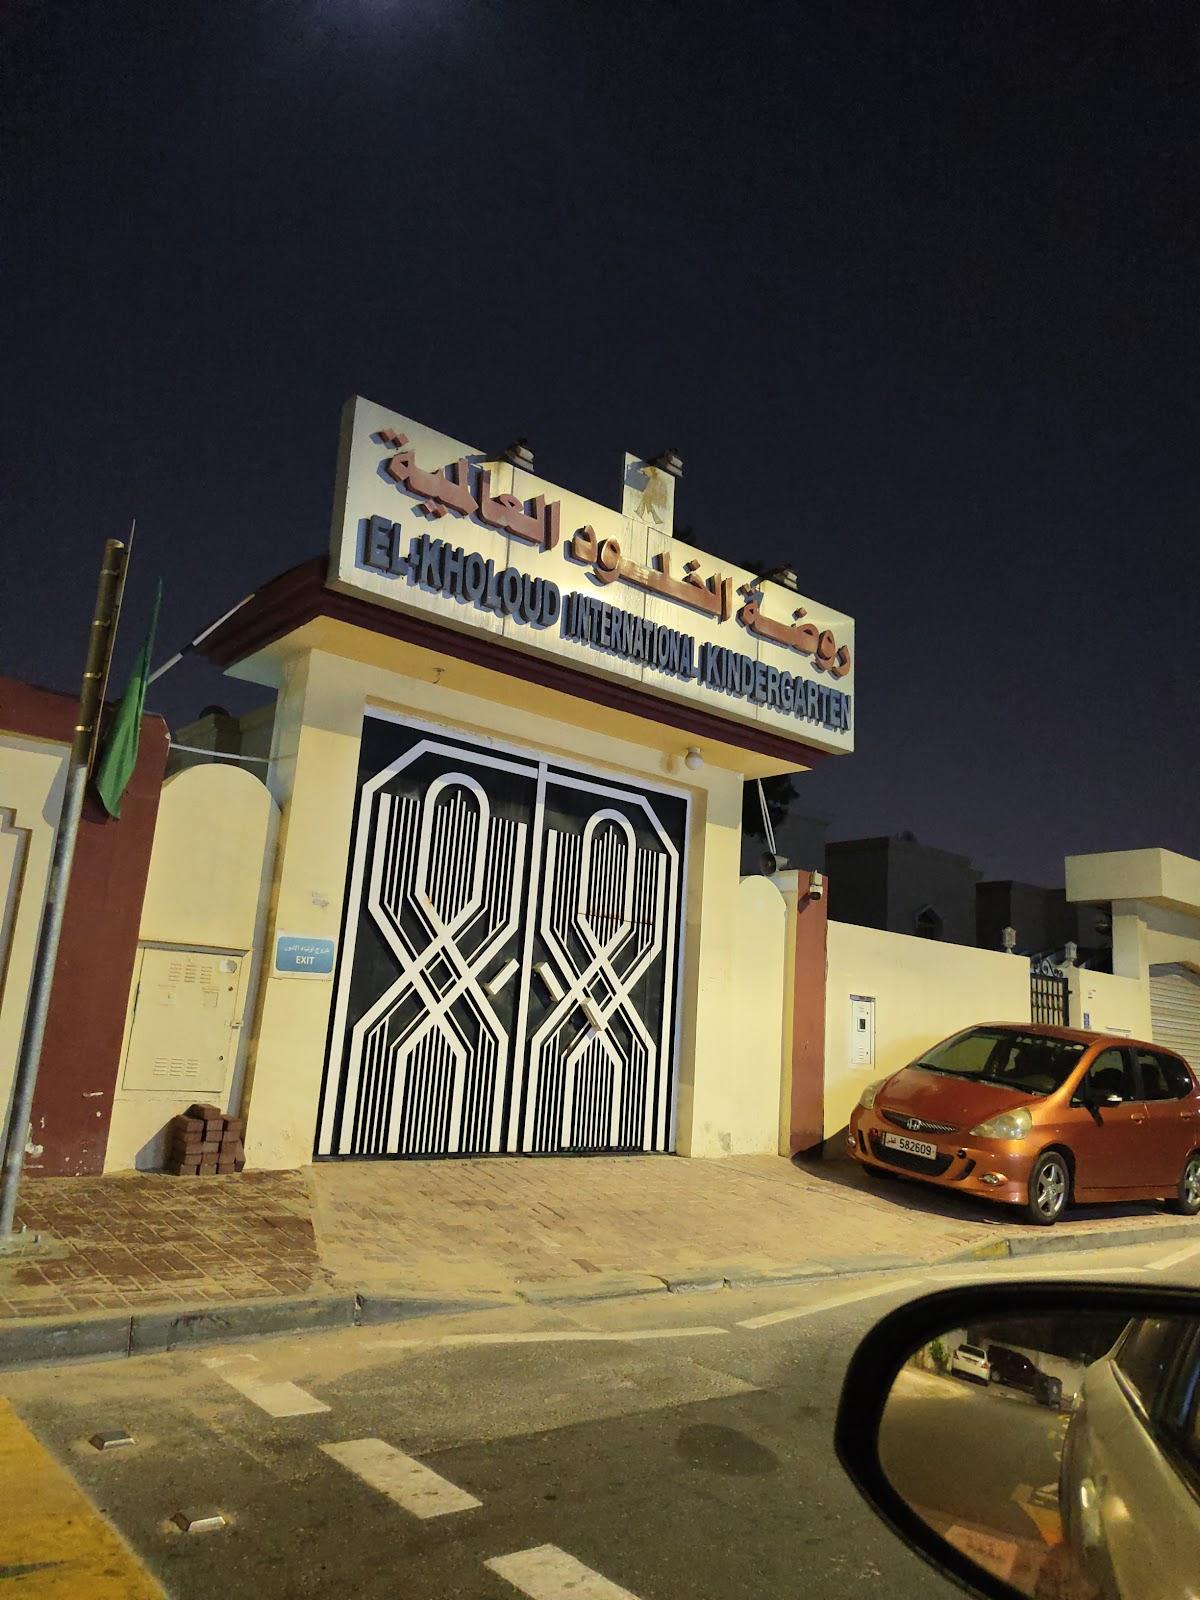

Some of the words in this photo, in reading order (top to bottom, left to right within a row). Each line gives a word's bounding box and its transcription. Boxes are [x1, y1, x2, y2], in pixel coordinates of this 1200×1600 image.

[374, 428, 561, 551] العالمية
[567, 525, 733, 623] الخلود
[358, 514, 561, 628] EL-KHOLOUD
[566, 590, 698, 680] INTERNATIONAL
[702, 642, 851, 732] KINDERGARTEN
[737, 583, 851, 680] روضة
[295, 955, 316, 965] EXIT
[899, 1138, 932, 1156] 582609
